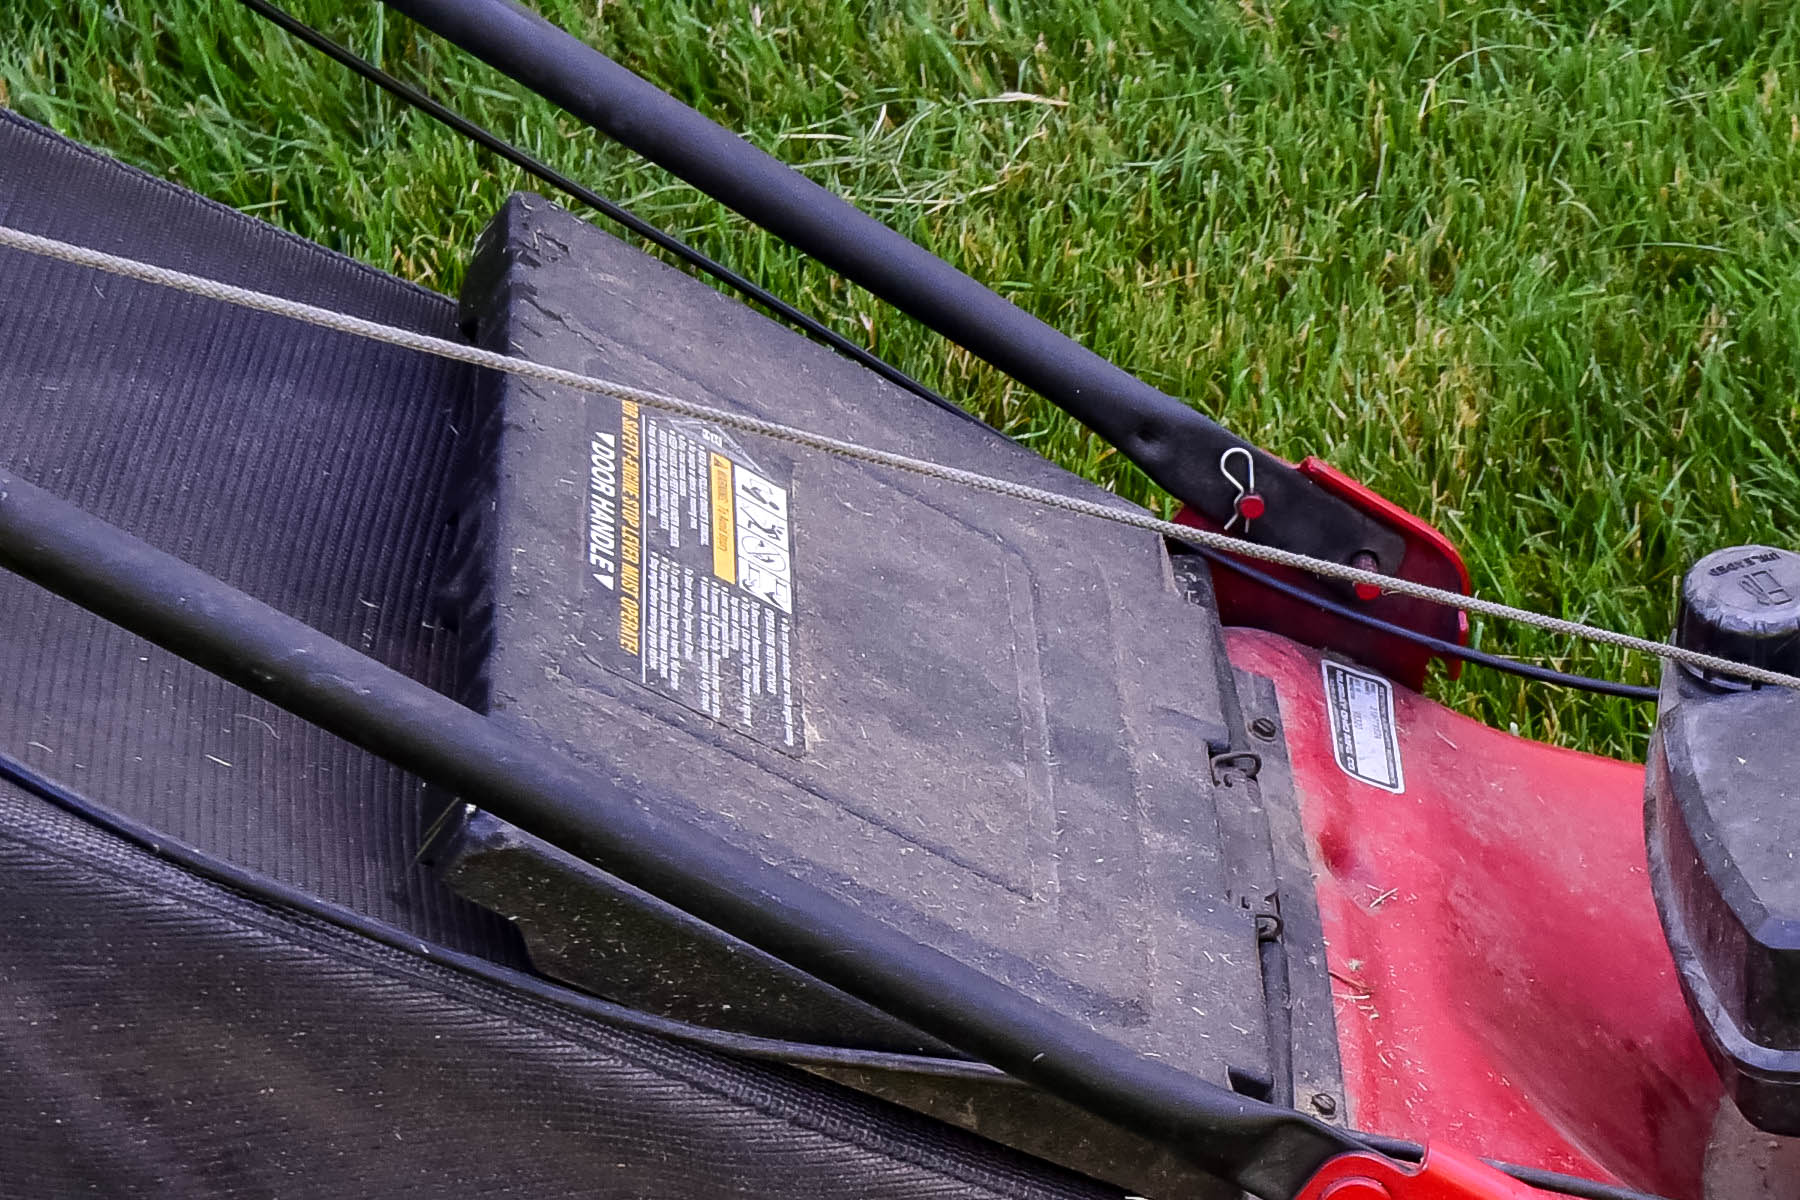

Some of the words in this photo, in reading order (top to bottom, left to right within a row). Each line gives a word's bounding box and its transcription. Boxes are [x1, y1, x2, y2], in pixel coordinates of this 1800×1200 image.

[622, 400, 638, 418] OR
[591, 442, 615, 496] DOOR
[622, 417, 638, 497] SAFETY-ENGINE
[590, 495, 614, 572] HANDLE
[622, 496, 638, 527] STOP
[622, 526, 638, 563] LEVER
[621, 563, 638, 598] MUST
[620, 597, 638, 655] OPERATE!
